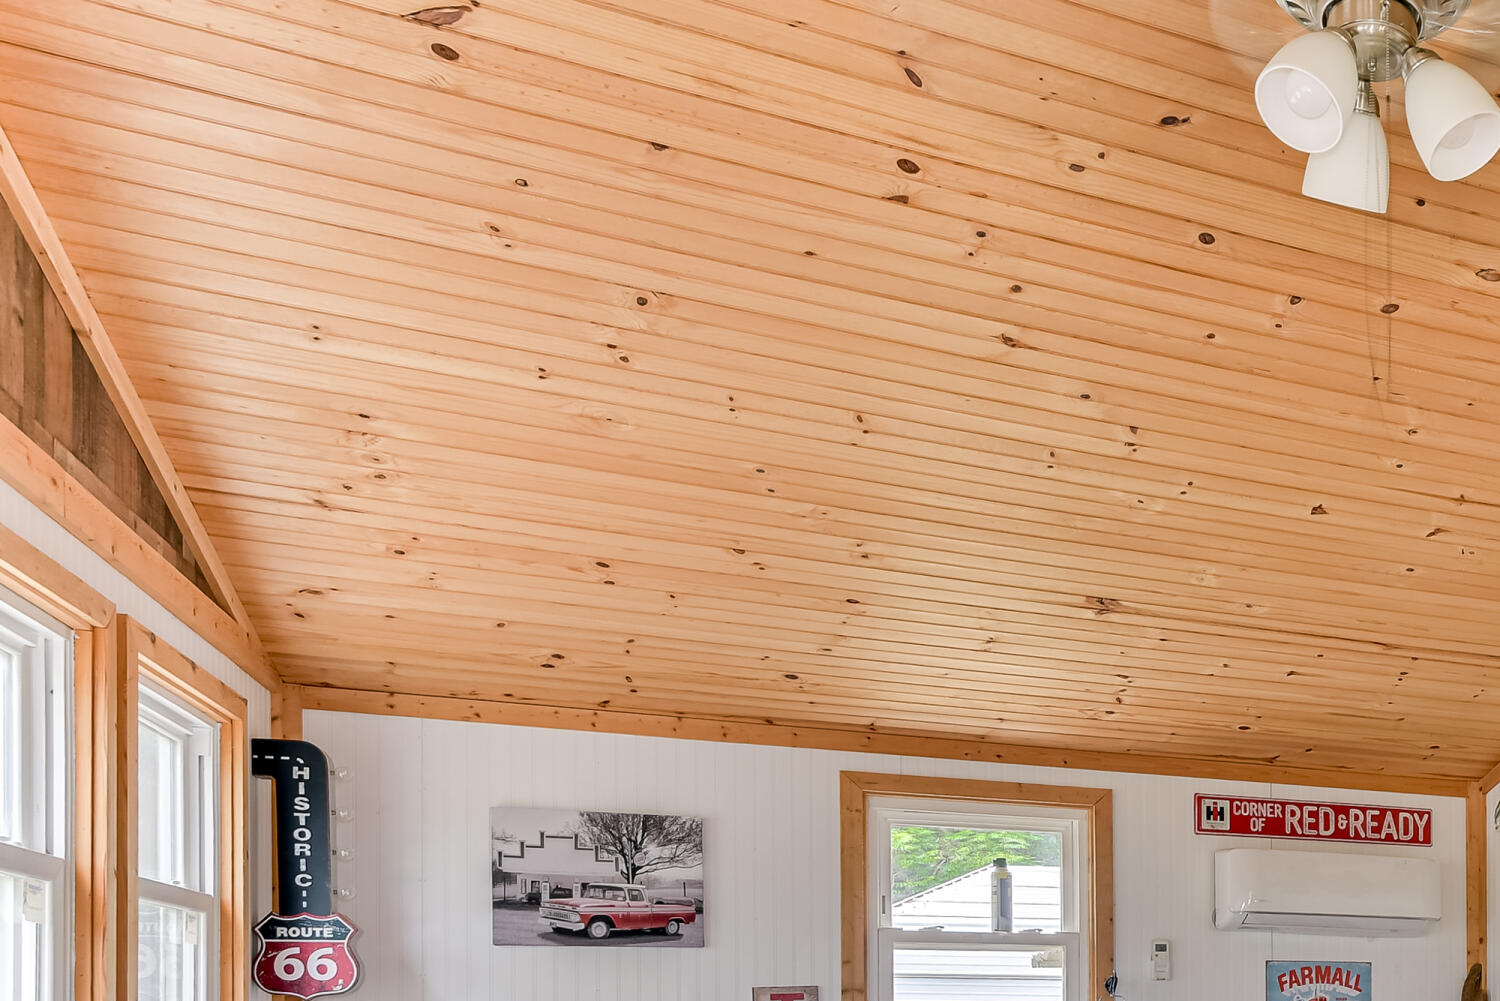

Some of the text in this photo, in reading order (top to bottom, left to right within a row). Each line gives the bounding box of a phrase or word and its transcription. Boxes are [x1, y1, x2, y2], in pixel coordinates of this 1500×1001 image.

[1232, 800, 1283, 819] CORNER
[1285, 804, 1429, 842] RED & READY
[292, 766, 313, 887] HISTORIC
[1250, 817, 1266, 832] OF
[276, 926, 334, 938] ROUTE
[273, 947, 338, 981] 66
[1277, 965, 1363, 993] FARMALL
